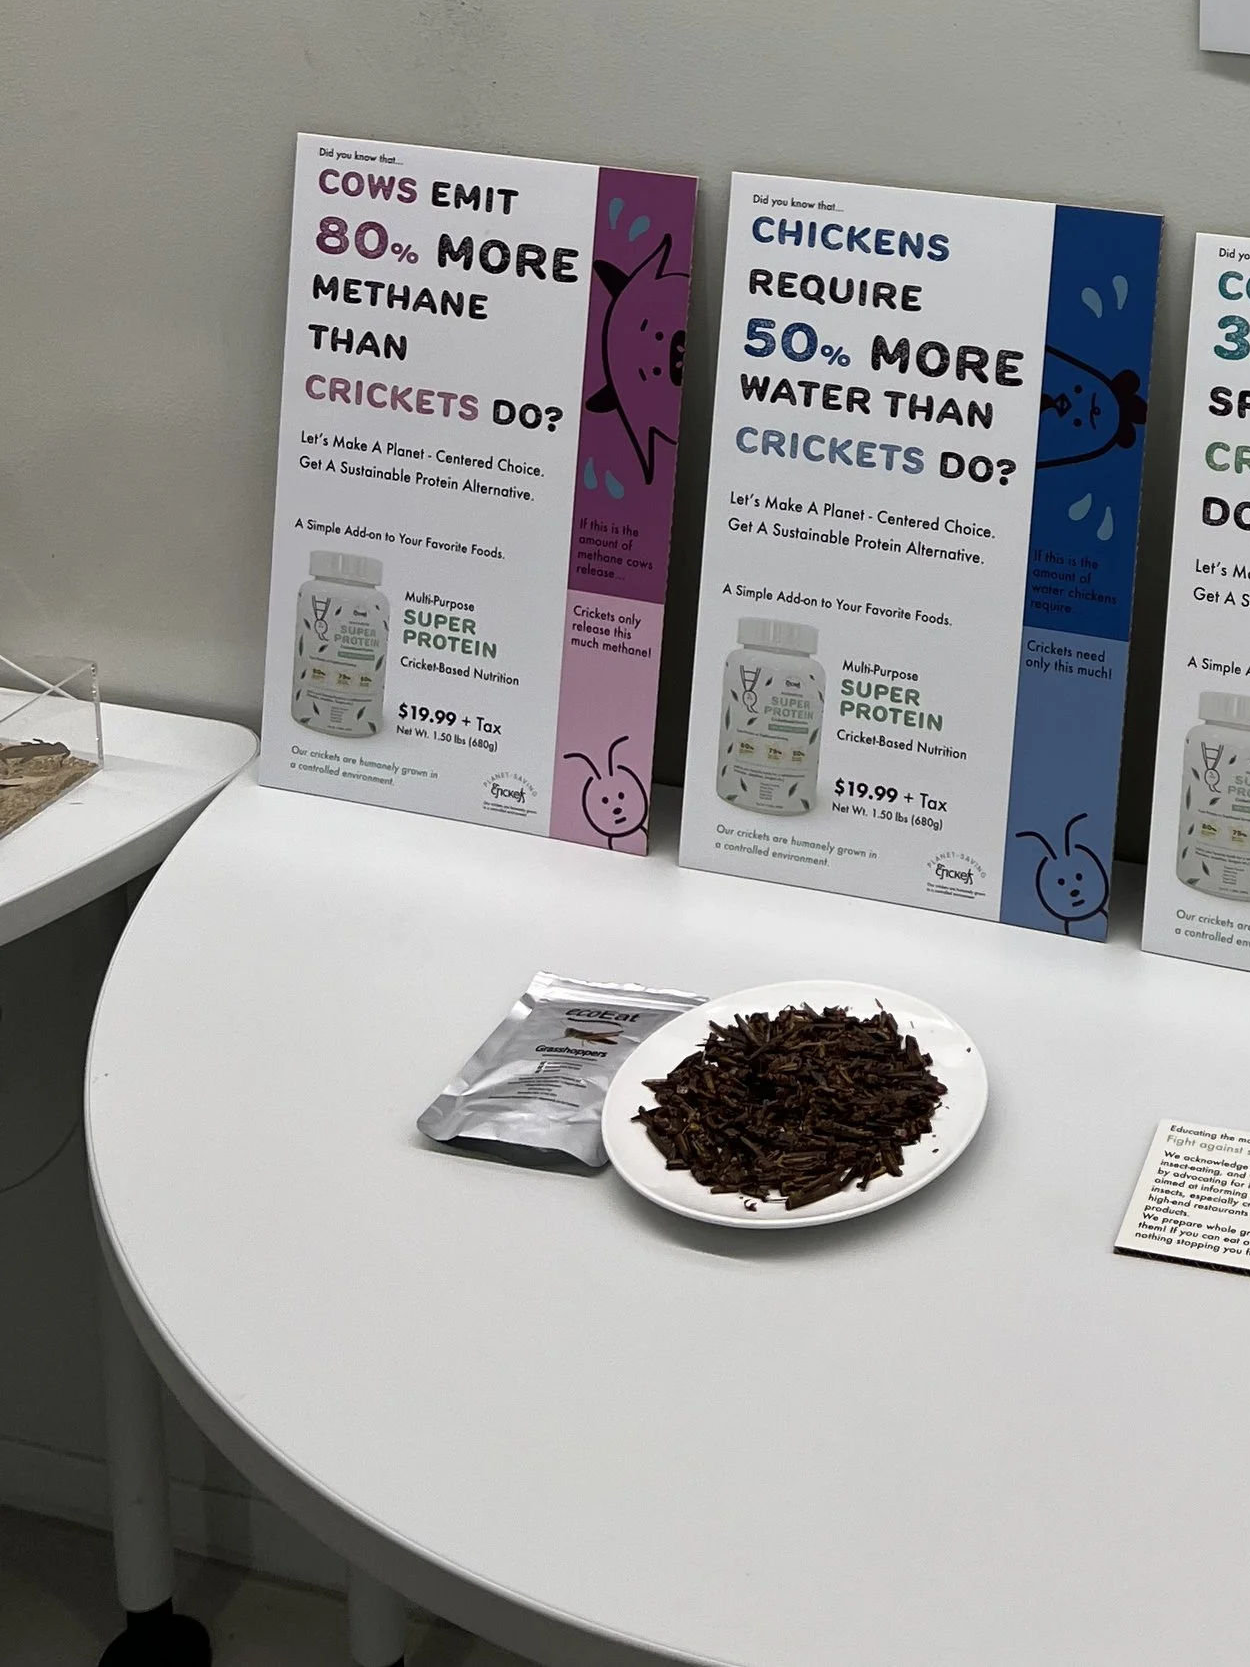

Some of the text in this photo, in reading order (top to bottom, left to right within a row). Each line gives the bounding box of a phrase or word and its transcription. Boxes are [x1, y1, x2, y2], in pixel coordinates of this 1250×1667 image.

[319, 169, 519, 215] COWS EMIT
[316, 216, 578, 283] 80% MORE
[752, 216, 949, 262] CHICKENS
[313, 274, 488, 320] METHANE
[749, 269, 922, 312] REQUIRE
[308, 324, 407, 361] THAN
[744, 318, 1024, 387] 50% MORE
[306, 374, 563, 432] CRICKETS DO?
[741, 374, 993, 430] WATER THAN
[736, 427, 1016, 486] CRICKETS DO?
[731, 491, 760, 507] Let's
[765, 495, 802, 512] Make
[807, 501, 818, 514] A
[824, 503, 864, 521] Planet
[877, 511, 939, 531] Centered
[945, 519, 995, 538] Choice.
[403, 629, 496, 659] PROTEIN
[404, 609, 476, 635] SUPER
[399, 703, 456, 726] $19.99
[477, 717, 501, 735] Tax
[535, 1044, 607, 1058] Grasshoppers
[1170, 1124, 1217, 1140] Educating
[1220, 1133, 1235, 1141] the
